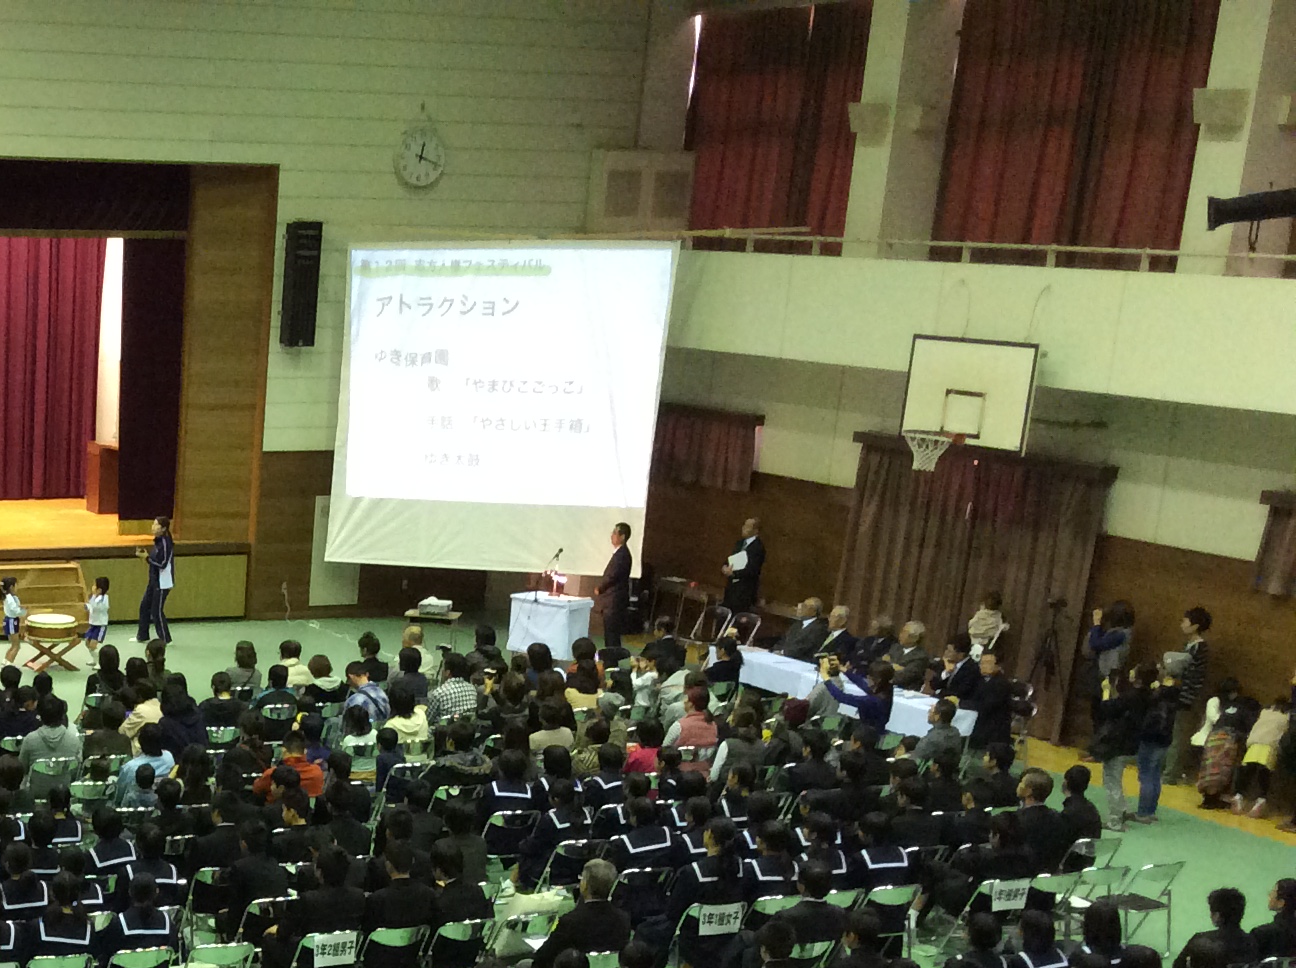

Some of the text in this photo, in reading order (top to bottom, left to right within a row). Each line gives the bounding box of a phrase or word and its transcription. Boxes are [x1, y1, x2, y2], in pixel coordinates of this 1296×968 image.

[375, 293, 520, 318] アトラクション
